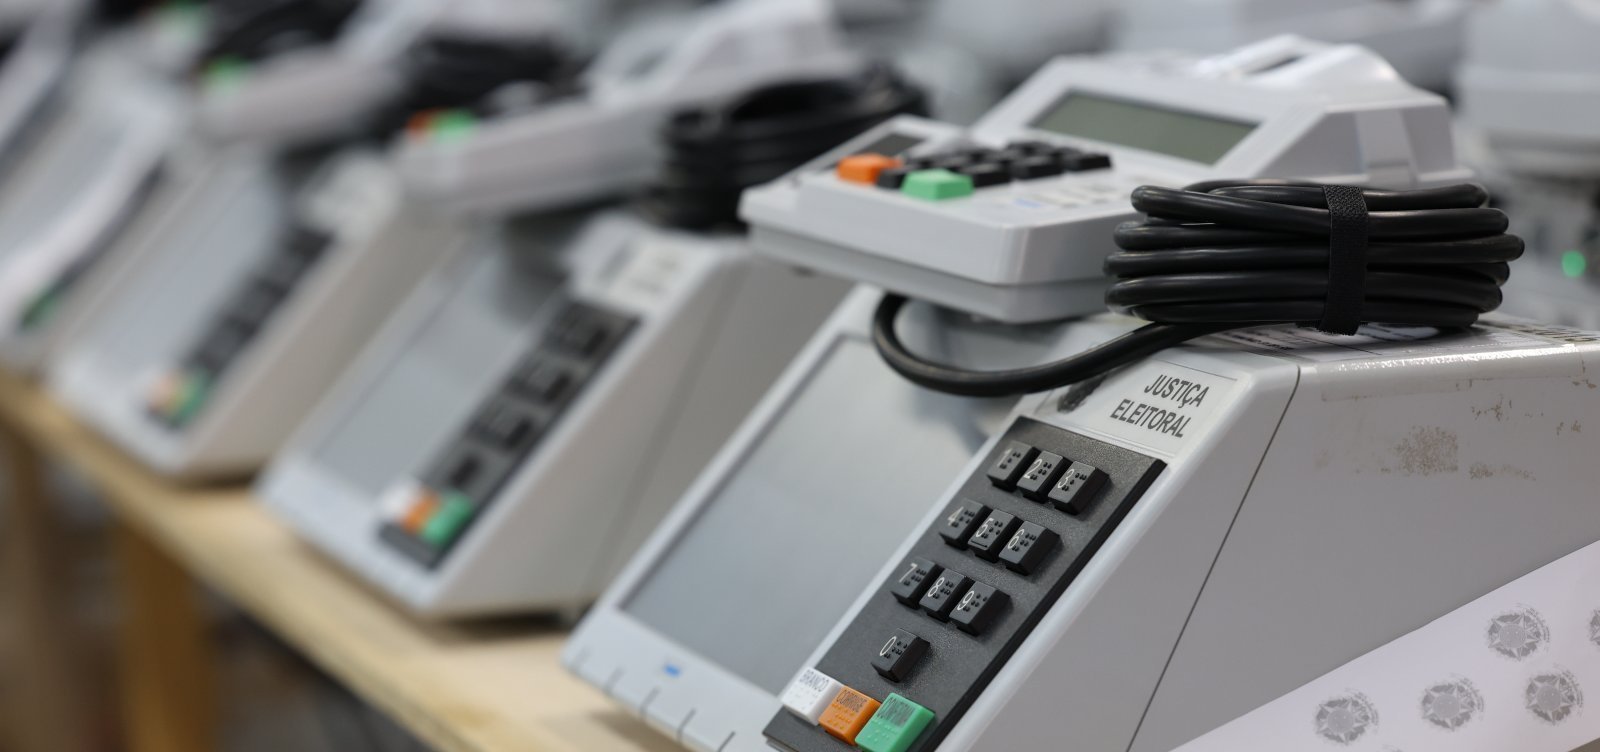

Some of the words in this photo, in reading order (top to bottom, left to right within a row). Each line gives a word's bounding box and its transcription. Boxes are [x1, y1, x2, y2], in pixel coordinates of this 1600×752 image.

[1144, 374, 1210, 408] JUSTIÇA
[1110, 398, 1192, 438] ELEITORAL
[997, 447, 1012, 468] 1
[1024, 458, 1043, 479] 2
[1057, 468, 1075, 488] 3
[947, 506, 964, 526] 4
[975, 518, 994, 538] 5
[1007, 529, 1024, 549] 6
[899, 563, 918, 583] 7
[927, 577, 945, 597] 8
[957, 590, 975, 611] 9
[879, 636, 897, 656] 0
